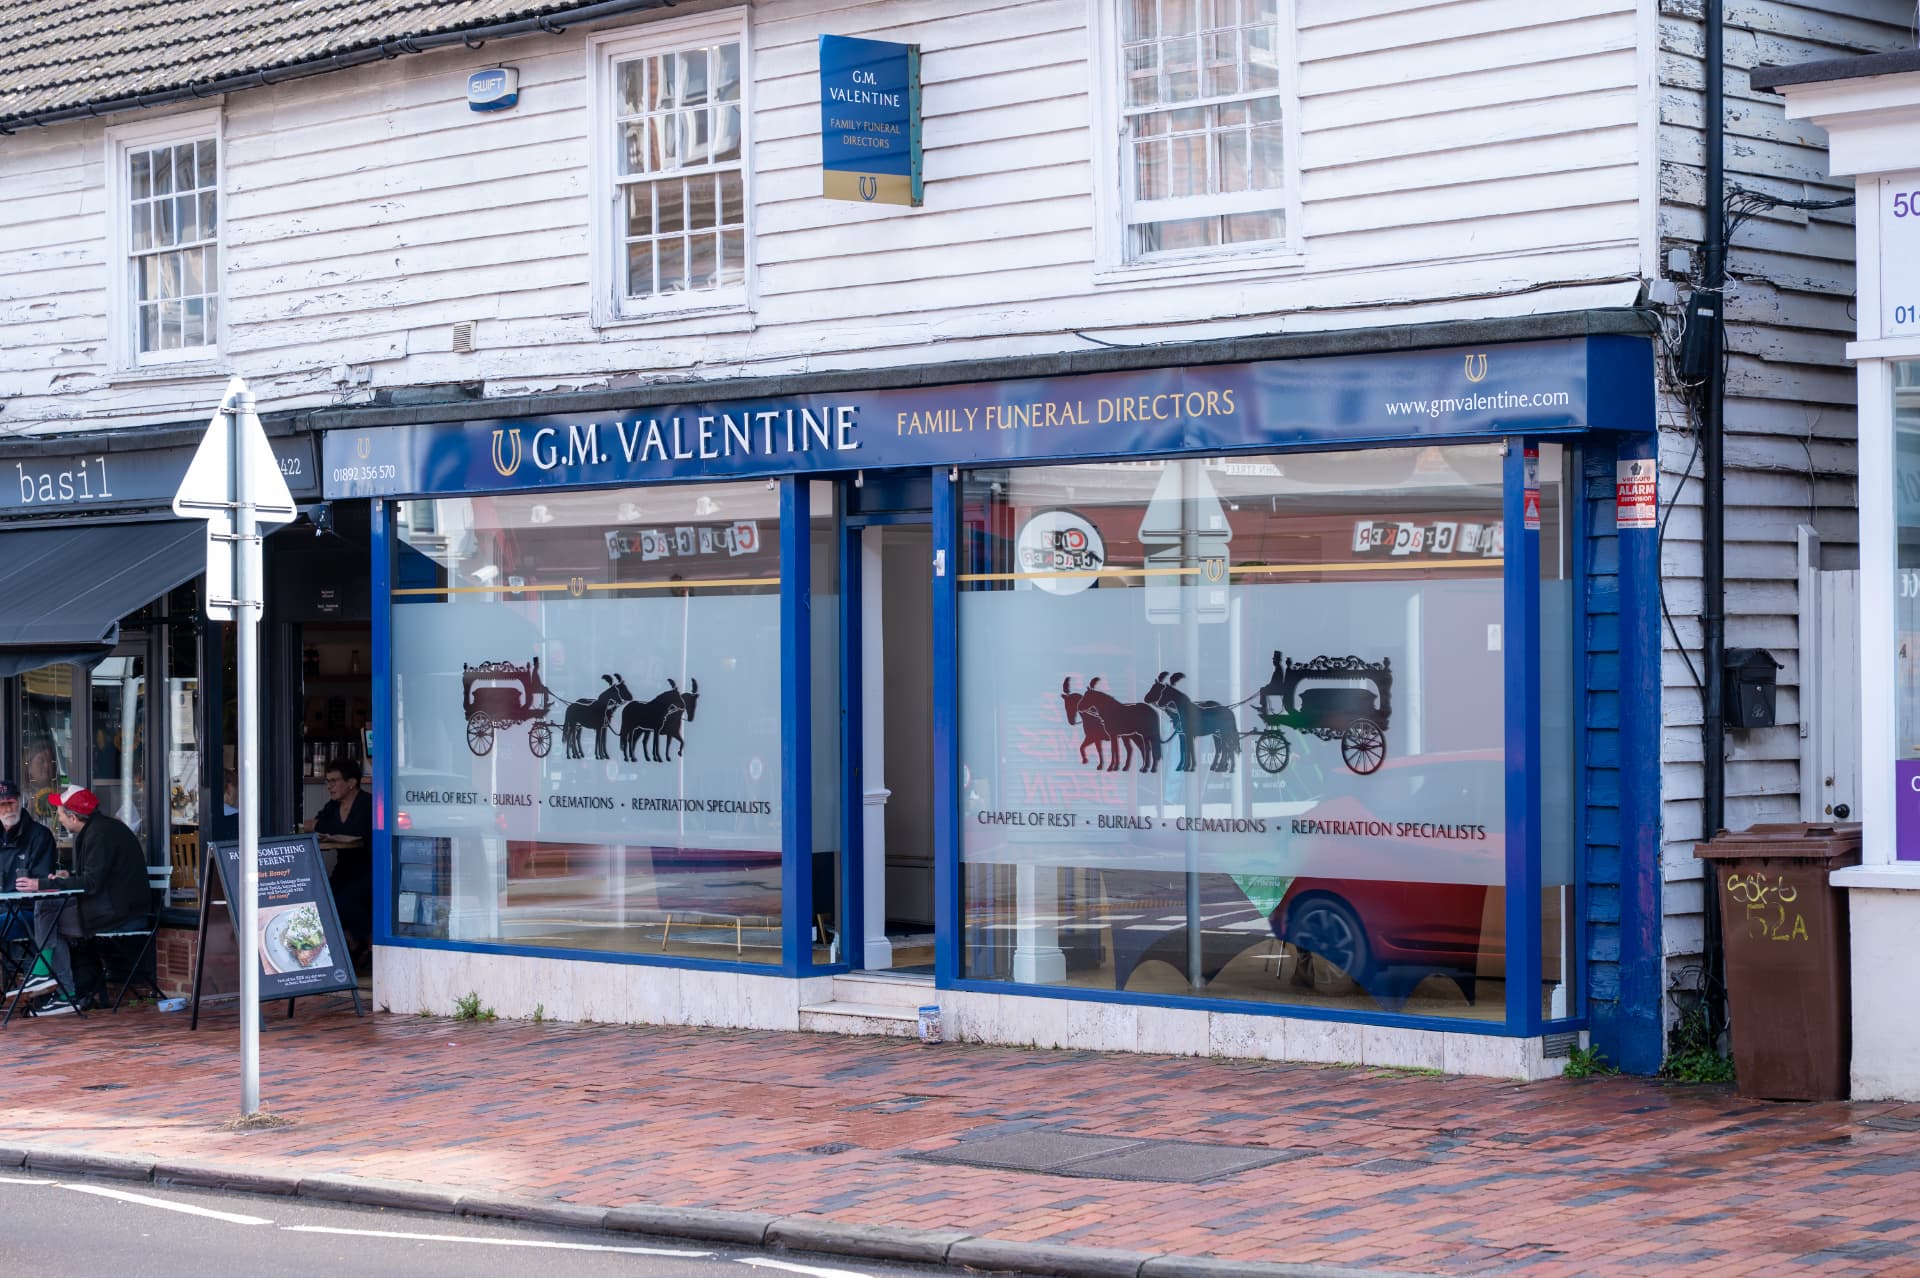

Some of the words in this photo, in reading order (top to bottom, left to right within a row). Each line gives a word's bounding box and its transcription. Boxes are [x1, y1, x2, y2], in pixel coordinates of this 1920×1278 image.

[471, 77, 504, 93] SWIFT
[852, 70, 877, 85] G.M.
[829, 87, 900, 107] VALENTINE
[830, 118, 861, 130] FAMILY
[863, 121, 901, 134] FUNERAL
[843, 135, 890, 149] DIRECTORS
[897, 407, 978, 436] FAMILY
[986, 401, 1090, 431] FUNERAL
[1098, 389, 1236, 424] DIRECTORS
[1385, 391, 1569, 418] www.gmvalentine.com
[532, 423, 608, 470] G.M.
[615, 405, 860, 463] VALENTINE
[280, 457, 302, 475] 422
[333, 467, 359, 482] 01892
[360, 466, 378, 480] 356
[379, 464, 396, 479] 570
[16, 456, 113, 503] basil
[1618, 484, 1655, 496] ALARM
[405, 790, 441, 804] CHAPEL
[442, 791, 455, 804] OF
[456, 791, 478, 804] REST
[492, 793, 532, 806] BURIALS
[548, 794, 614, 810] CREMATIONS
[631, 797, 704, 812] REPATRIATION
[706, 799, 771, 815] SPECIALISTS
[977, 810, 1026, 826] CHAPEL
[1028, 812, 1046, 826] OF
[1047, 813, 1077, 827] REST
[1098, 814, 1152, 830] BURIALS
[1175, 816, 1267, 834] CREMATIONS
[1291, 819, 1392, 837] REPATRIATION
[1396, 822, 1487, 840] SPECIALISTS
[258, 854, 295, 867] FERENT?
